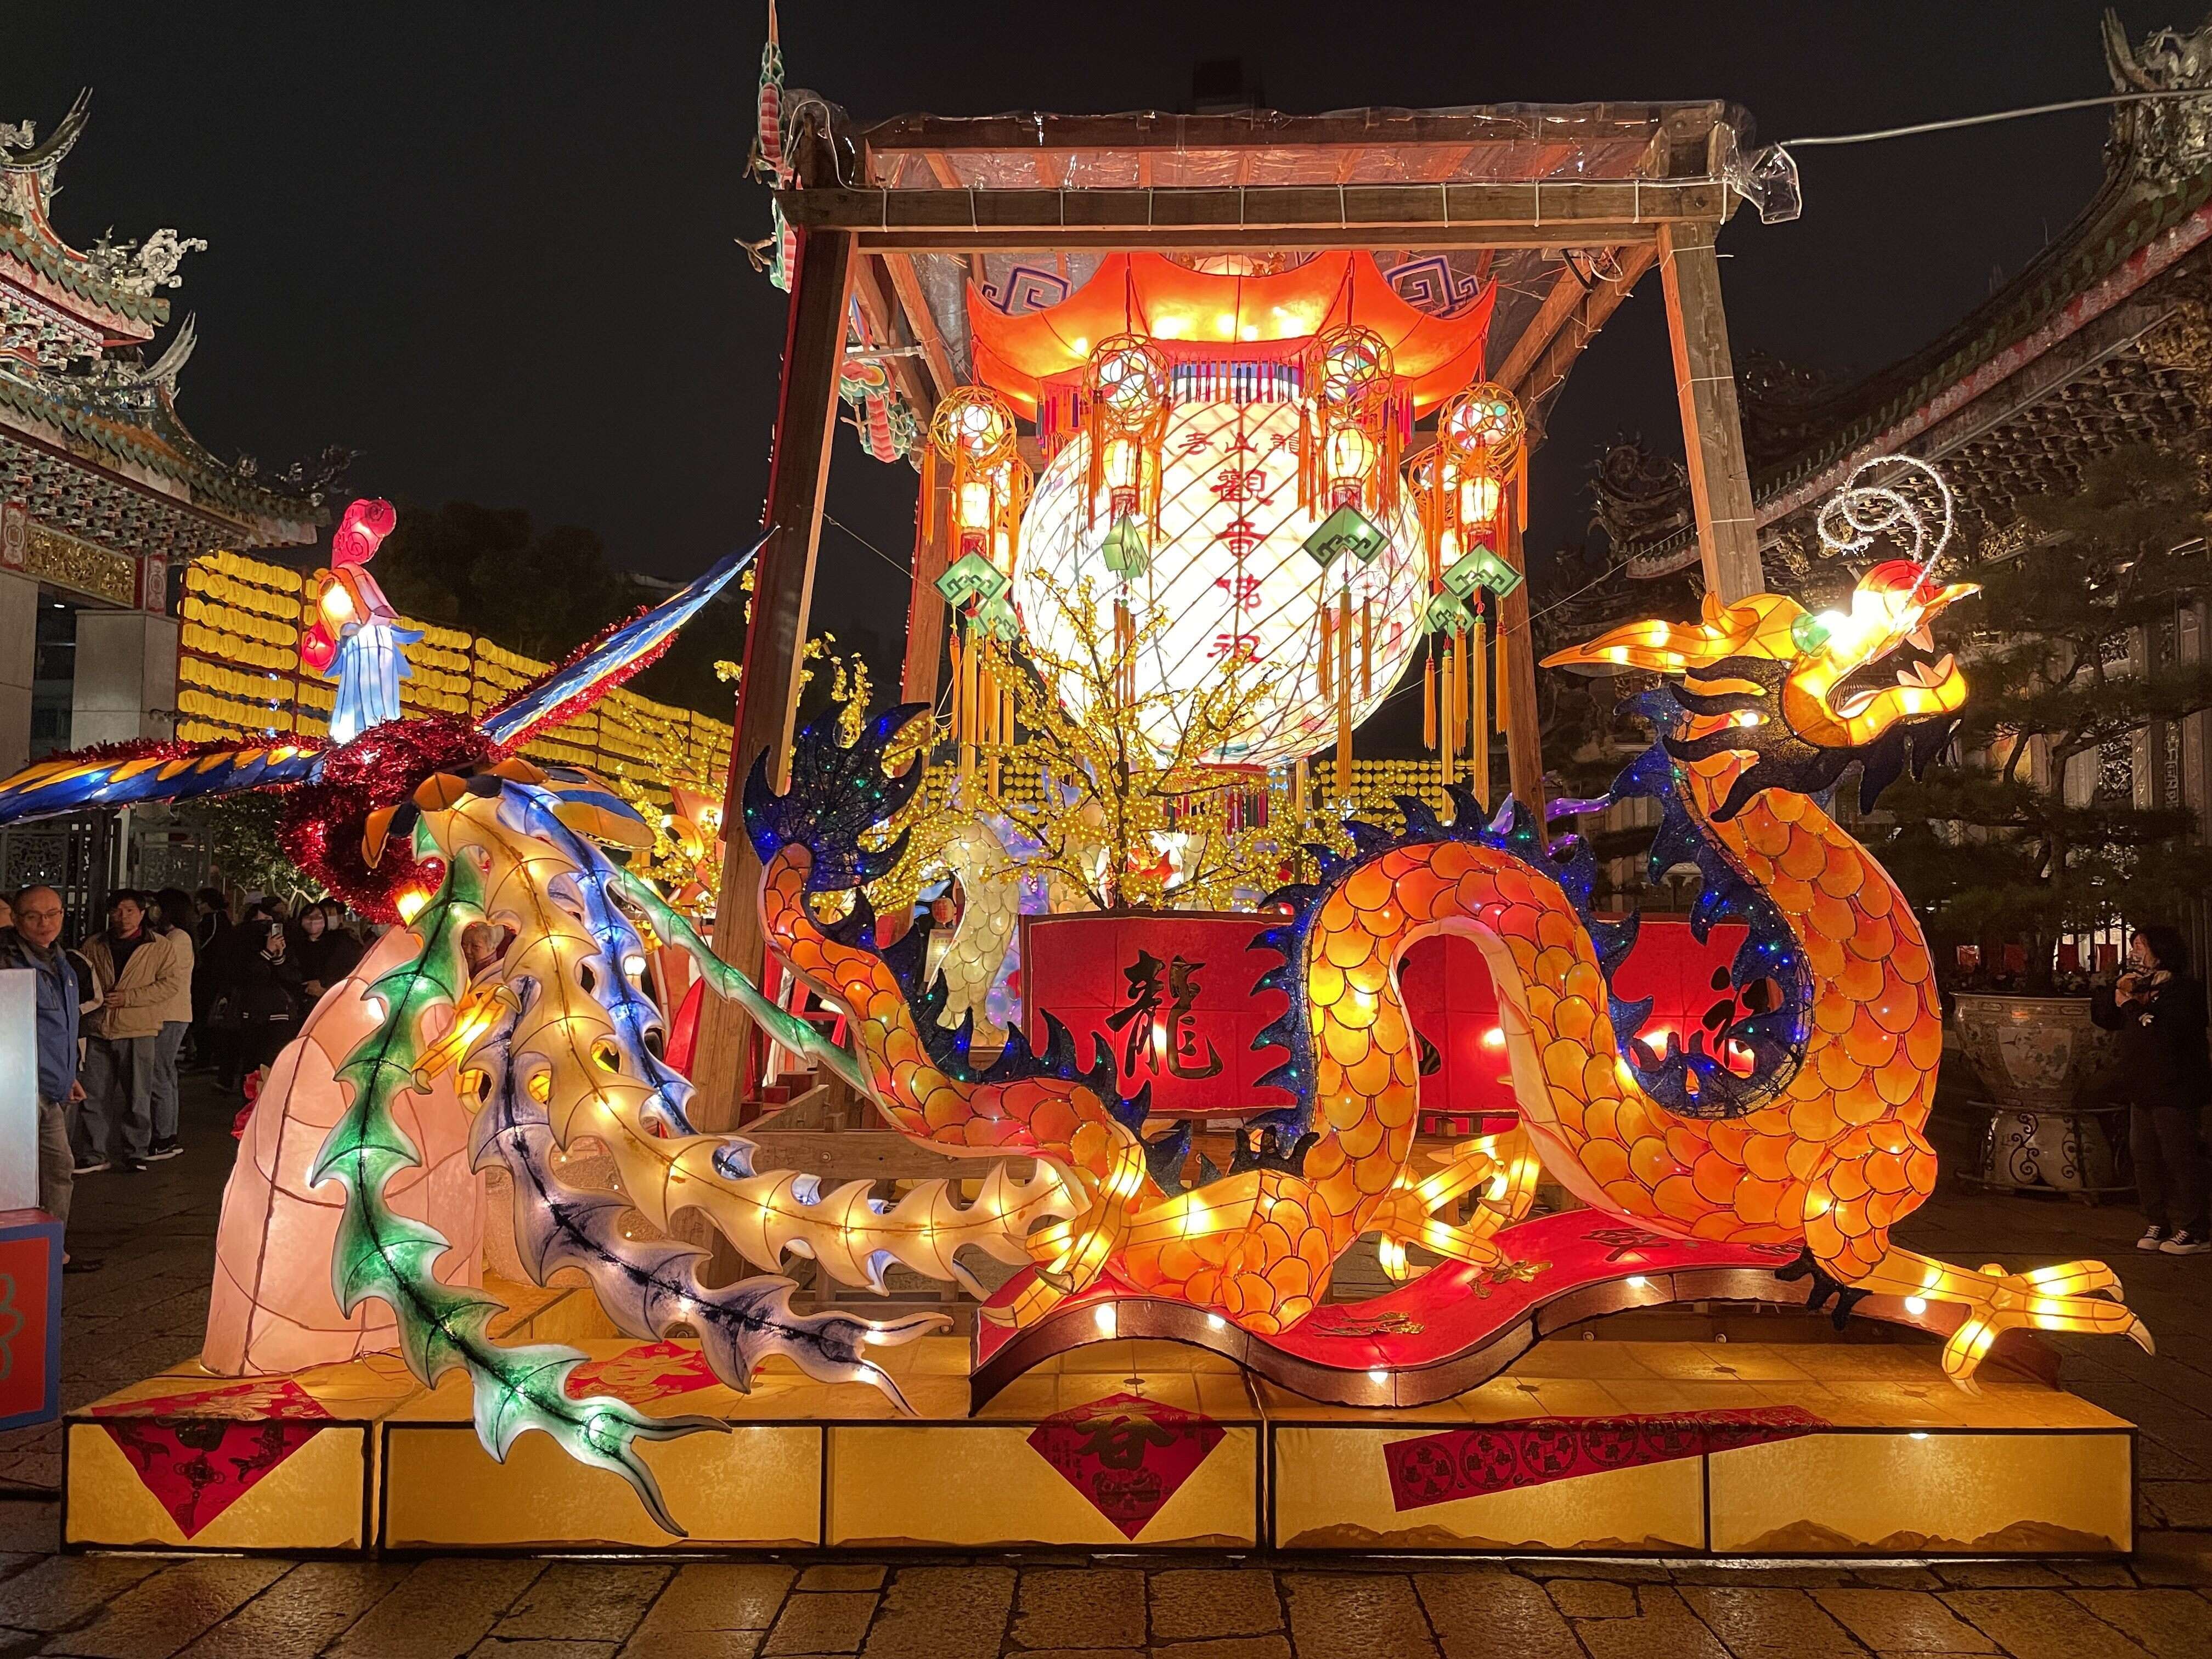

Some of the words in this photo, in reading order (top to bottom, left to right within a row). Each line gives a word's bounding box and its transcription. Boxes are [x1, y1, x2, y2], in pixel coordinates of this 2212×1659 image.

[1207, 469, 1274, 663] 觀音佛祖
[1105, 949, 1223, 1080] 龍
